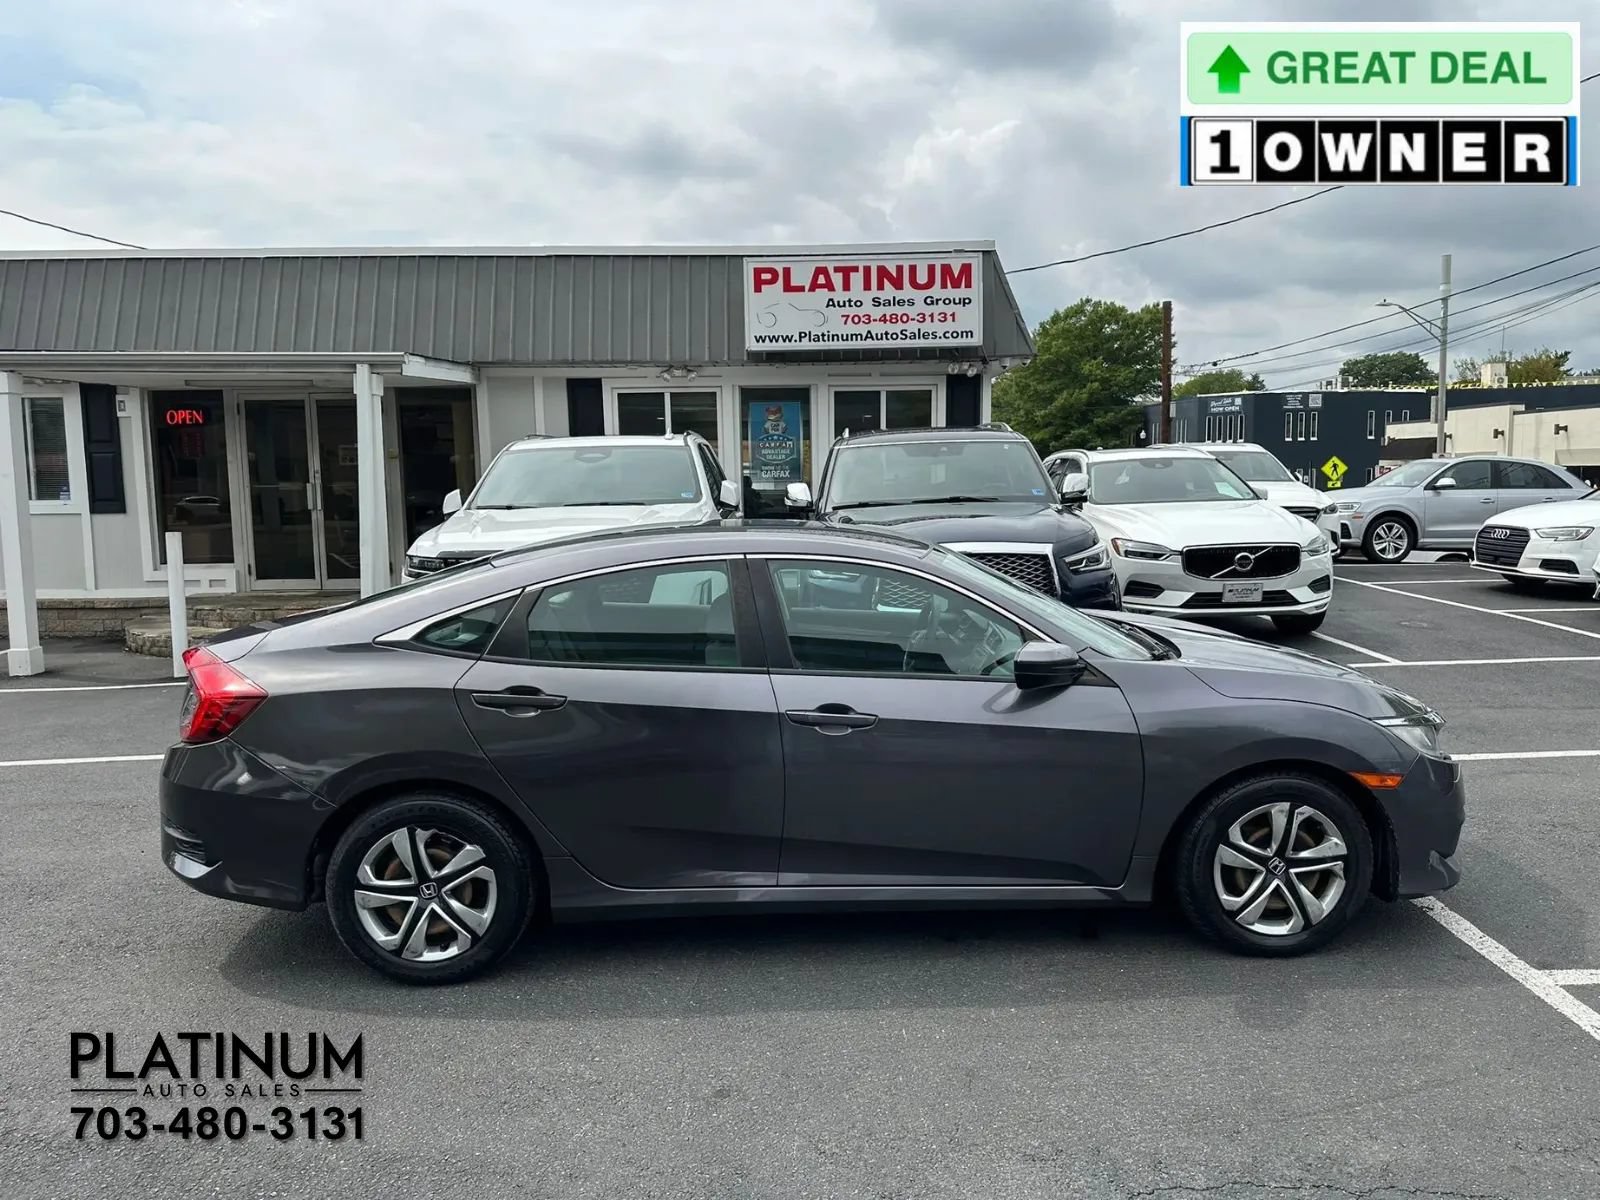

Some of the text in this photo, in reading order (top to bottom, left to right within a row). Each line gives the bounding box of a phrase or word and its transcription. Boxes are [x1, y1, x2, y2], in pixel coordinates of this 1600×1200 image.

[753, 263, 972, 293] PLATINUM
[825, 295, 972, 309] Auto Sales Group
[840, 312, 957, 326] 703-480-3131
[754, 329, 974, 344] www.PlatinumAutoSales.com
[166, 409, 203, 425] OPEN
[761, 470, 790, 478] CARFAX
